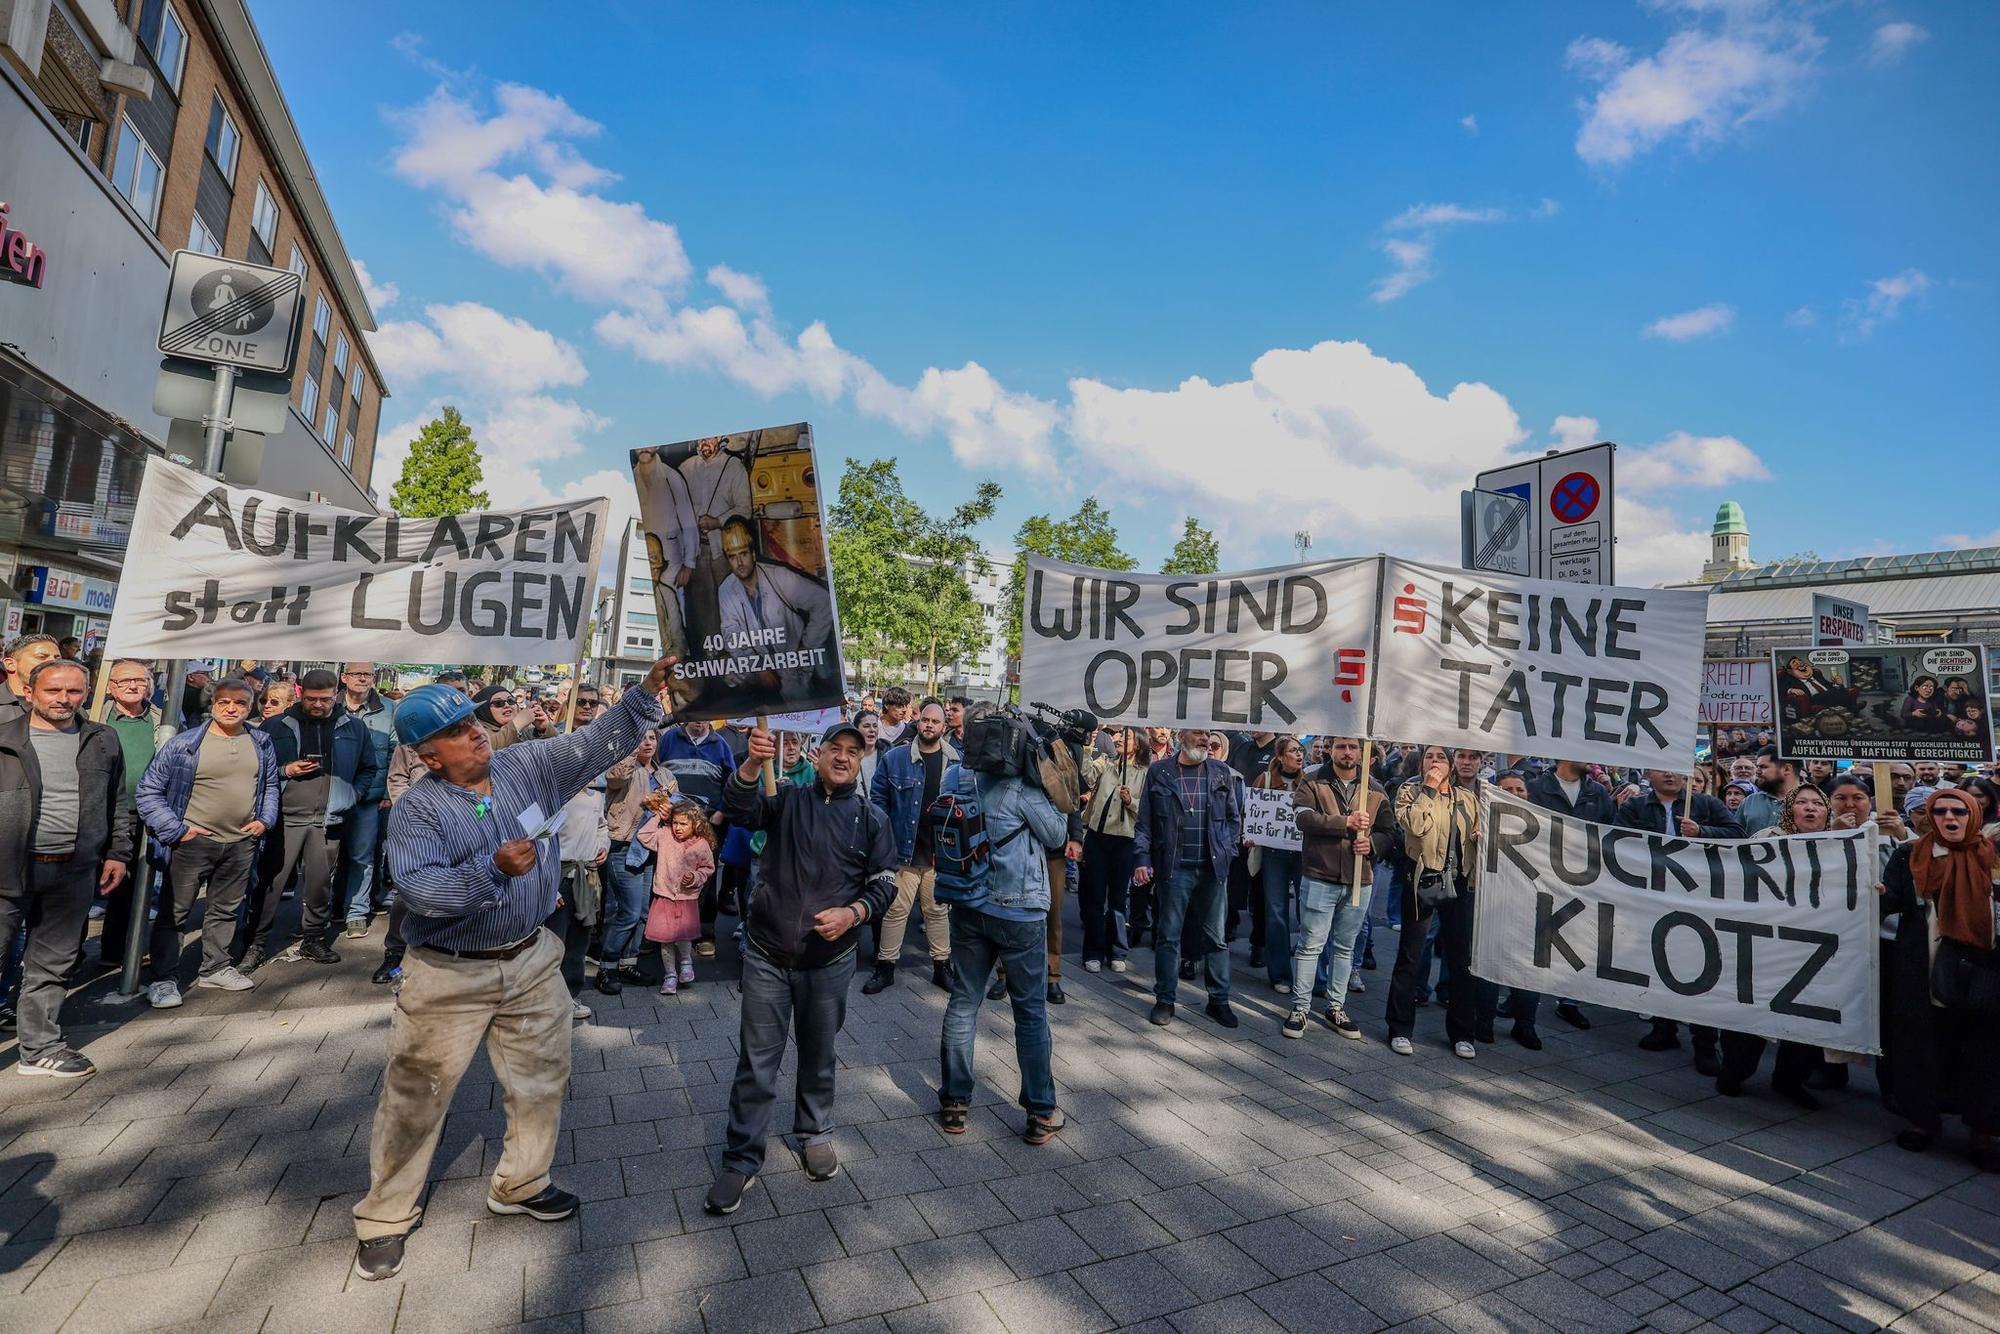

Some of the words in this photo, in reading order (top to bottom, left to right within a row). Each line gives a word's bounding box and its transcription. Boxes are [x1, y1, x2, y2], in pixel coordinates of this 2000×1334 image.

[193, 336, 258, 359] ZONE
[1582, 536, 1597, 544] Platz
[1491, 554, 1518, 570] ZONE
[1559, 557, 1591, 566] werktags
[1582, 567, 1592, 576] Sa
[351, 562, 586, 640] LÜGEN
[1030, 569, 1145, 641] WIR
[1165, 575, 1328, 635] SIND
[1440, 581, 1646, 661] KEINE
[1833, 603, 1854, 621] UNSER
[1820, 615, 1864, 643] ERSPARTES
[702, 634, 724, 652] 40
[727, 627, 787, 649] JAHRE
[673, 648, 826, 680] SCHWARZARBEIT
[1939, 657, 1973, 665] RICHTIGEN
[1702, 662, 1755, 686] RHEIT
[1083, 649, 1298, 726] OPFER
[1710, 690, 1737, 700] oder
[1741, 693, 1764, 701] nur
[1440, 658, 1670, 750] TÄTER
[1698, 701, 1770, 723] AUPTET?
[1791, 745, 1854, 756] AUFKLÄRUNG
[1861, 747, 1907, 757] HAFTUNG
[1914, 748, 1984, 759] GERECHTIGKEIT
[1794, 739, 1849, 747] VERANTWORTUNG
[1850, 739, 1890, 747] ÜBERNEHMEN
[1949, 741, 1981, 749] ERKLÄREN
[1250, 788, 1284, 802] Mehr
[1249, 803, 1270, 819] für
[1275, 807, 1295, 822] Ba
[1247, 822, 1264, 835] als
[1265, 822, 1281, 838] für
[1533, 891, 1842, 1025] KLOTZ
